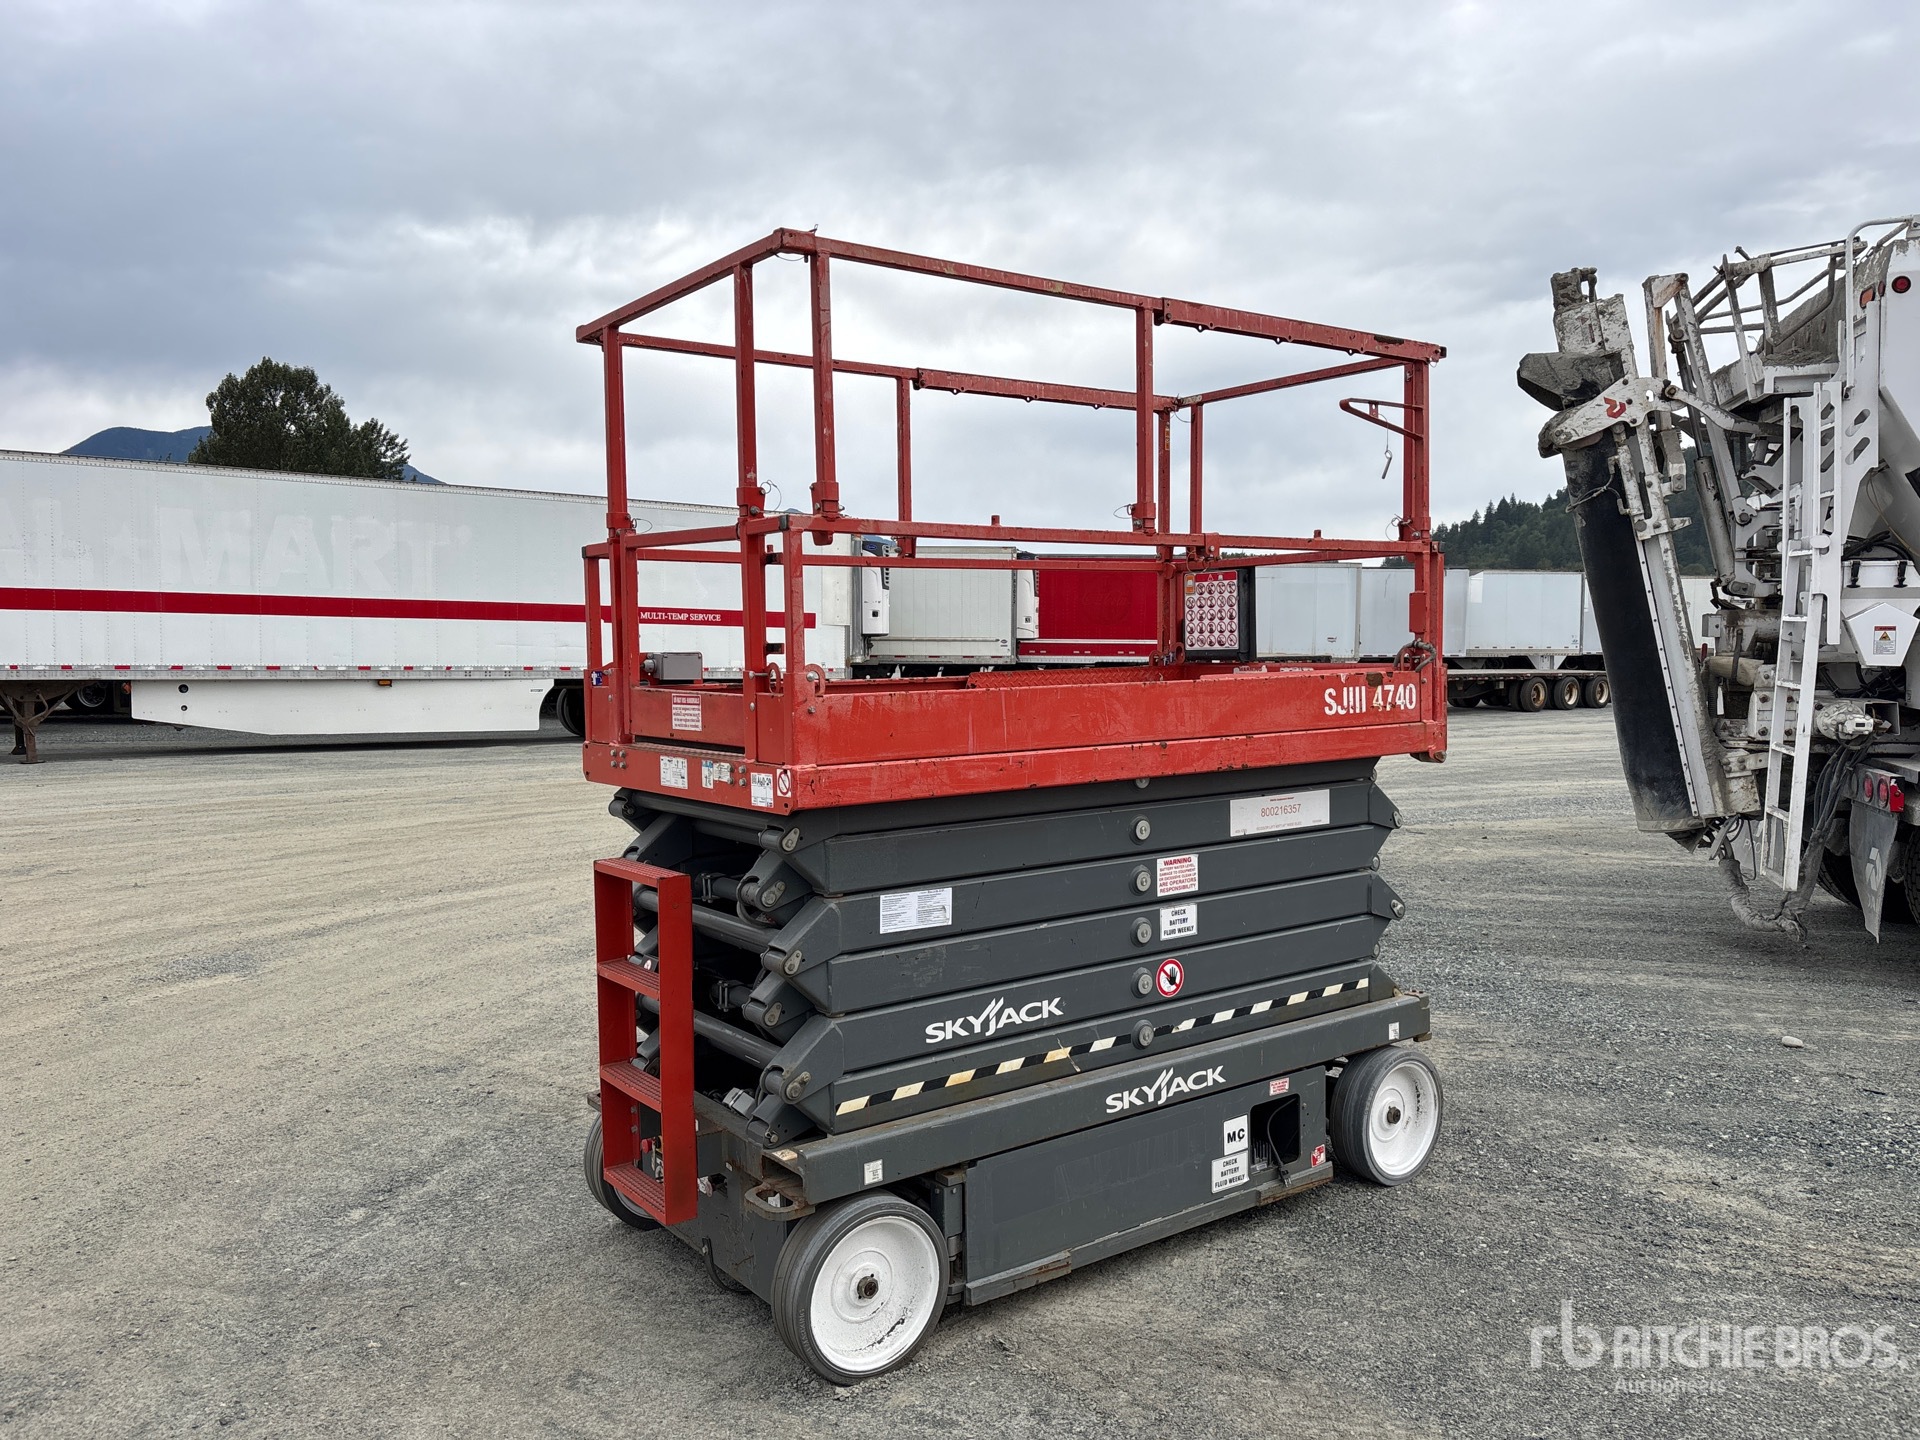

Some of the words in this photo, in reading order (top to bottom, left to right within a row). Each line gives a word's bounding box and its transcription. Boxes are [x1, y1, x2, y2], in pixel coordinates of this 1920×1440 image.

[640, 611, 688, 620] MULTI-TEMP
[689, 613, 722, 622] SERVICE
[1372, 683, 1417, 712] 4740
[1260, 803, 1302, 818] 800216357
[1163, 856, 1192, 867] WARNING
[1169, 876, 1197, 886] OPERATORS
[1159, 883, 1196, 894] RESPONSIBILITY
[1171, 908, 1187, 917] CHECK
[1169, 917, 1189, 926] BATTERY
[1163, 928, 1177, 936] FLUID
[1177, 925, 1195, 934] WEEKLY
[925, 996, 1064, 1044] SKYJACK
[1105, 1065, 1227, 1114] SKYJACK
[1227, 1127, 1245, 1143] MC
[1222, 1157, 1238, 1168] CHECK
[1220, 1166, 1240, 1178] BATTERY
[1214, 1179, 1228, 1189] FLUID
[1228, 1173, 1246, 1184] WEEKLY
